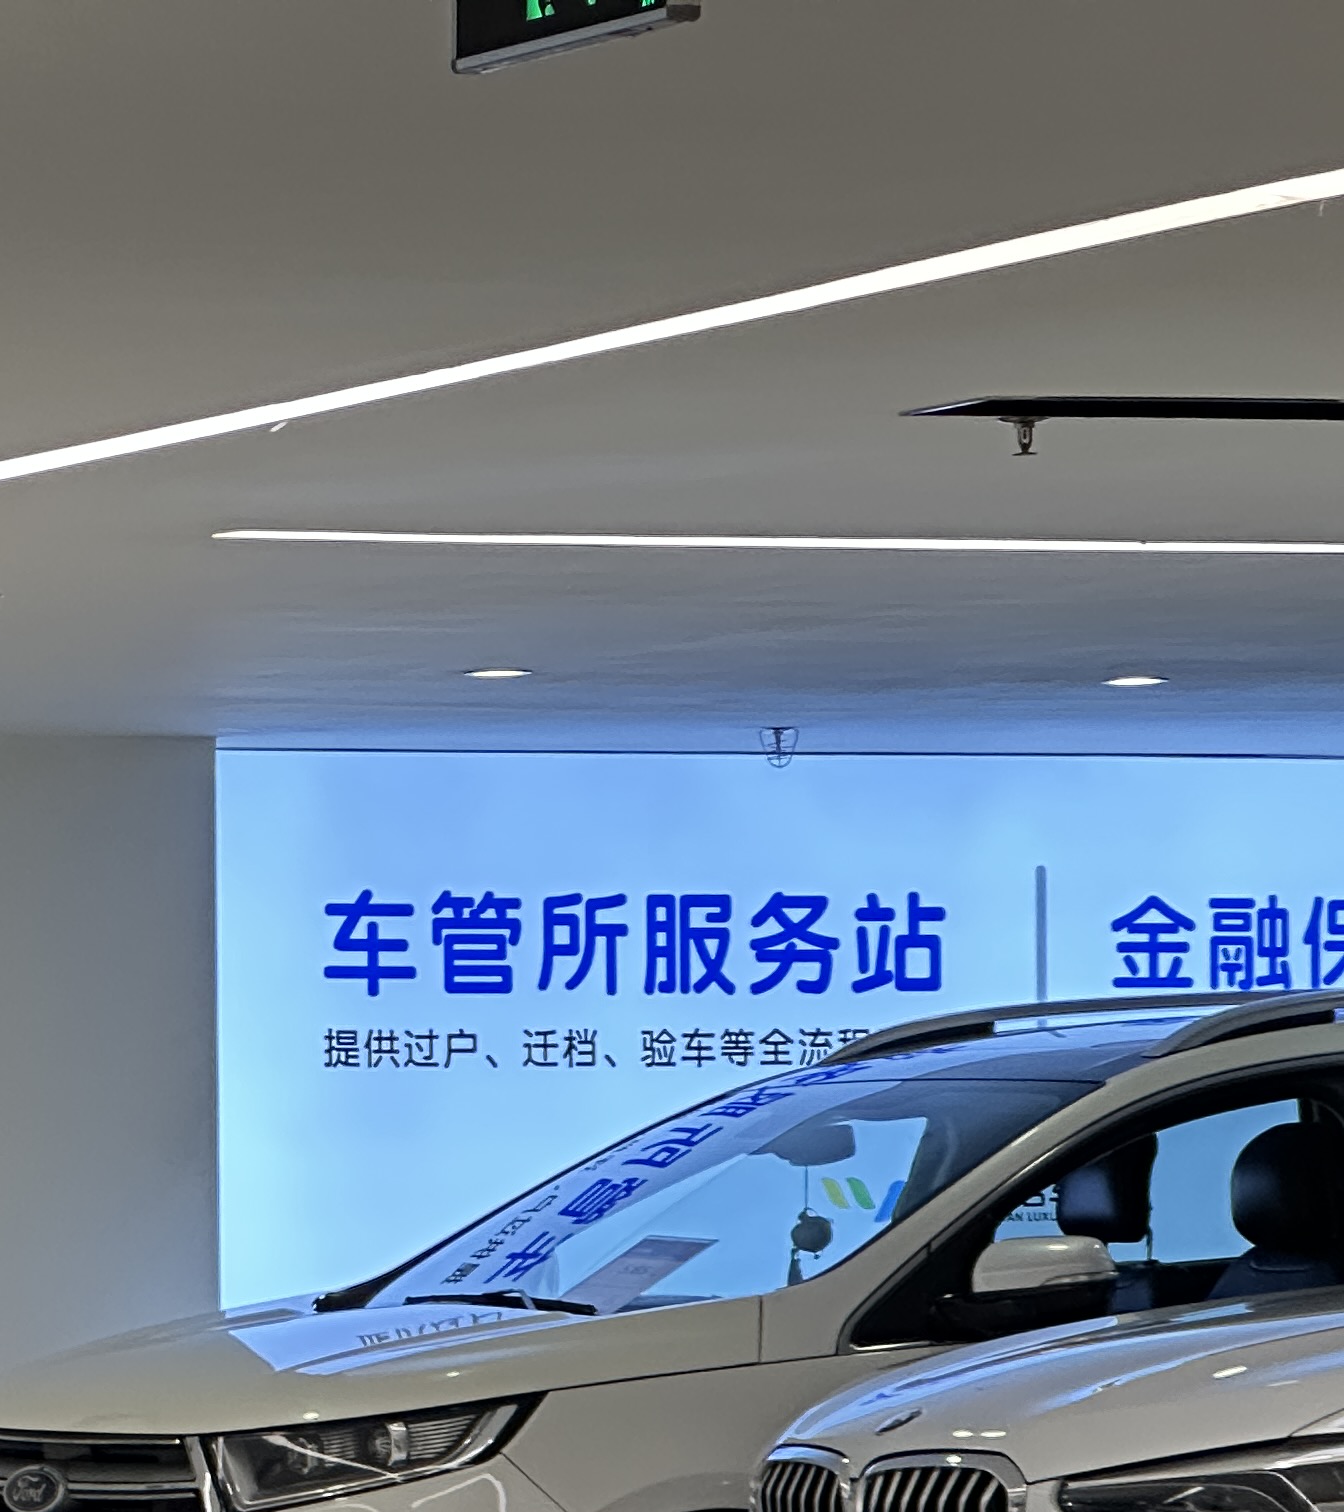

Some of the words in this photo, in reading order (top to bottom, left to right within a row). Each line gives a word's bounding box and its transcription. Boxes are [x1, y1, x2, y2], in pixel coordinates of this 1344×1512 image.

[323, 889, 946, 997] 车管所服务站
[12, 1475, 47, 1502] Ford
